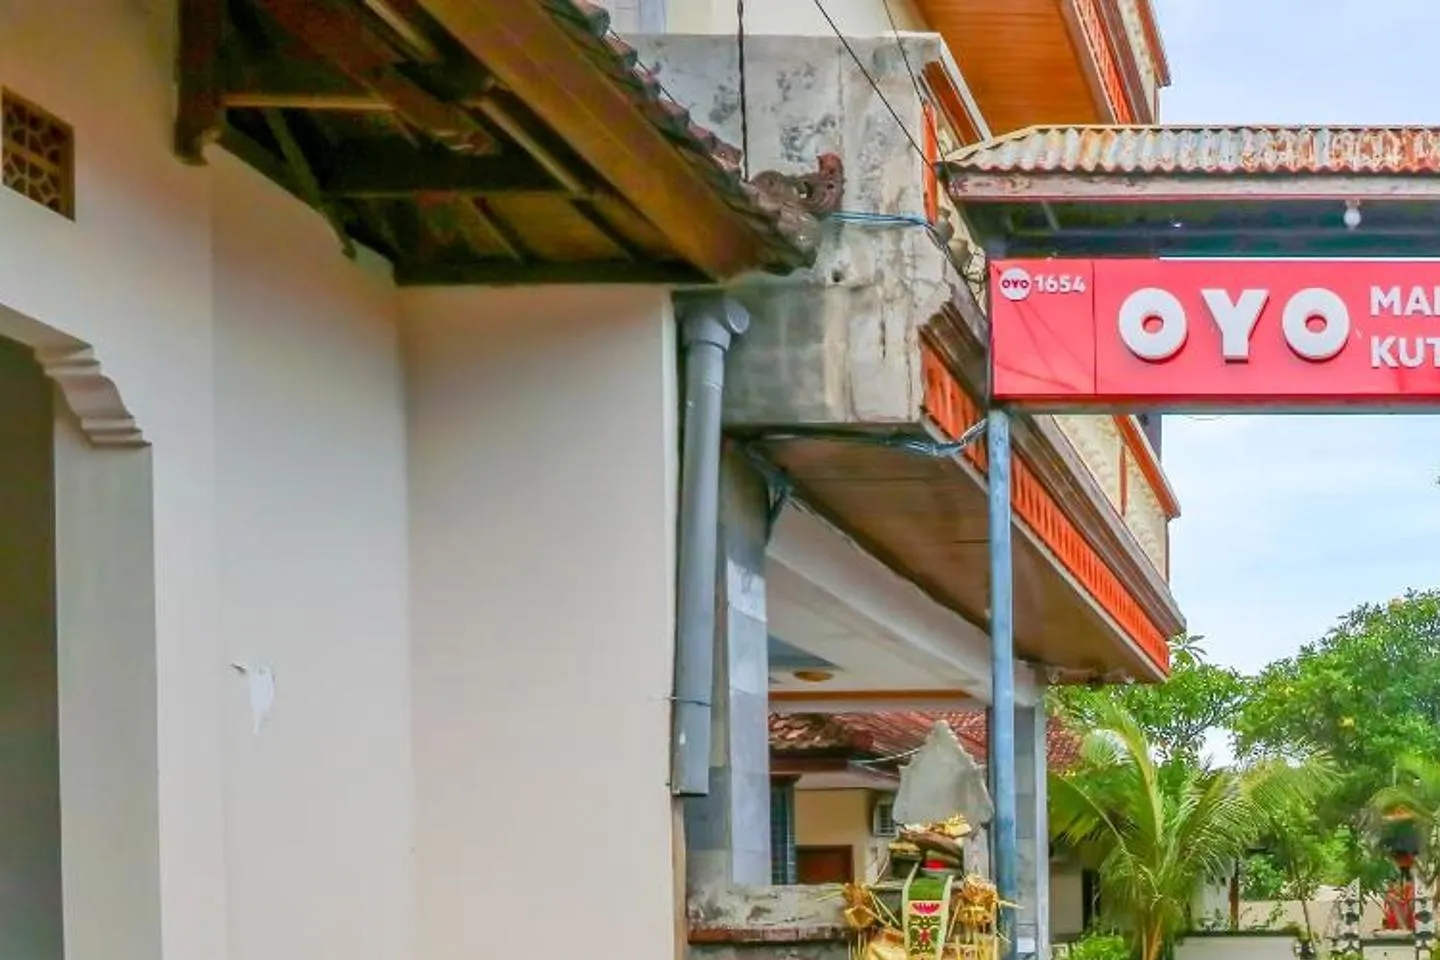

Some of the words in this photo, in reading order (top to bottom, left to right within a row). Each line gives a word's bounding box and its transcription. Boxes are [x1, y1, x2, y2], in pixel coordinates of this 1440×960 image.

[1001, 279, 1030, 290] OYO
[1034, 274, 1086, 293] 1654
[1118, 287, 1350, 363] OYO
